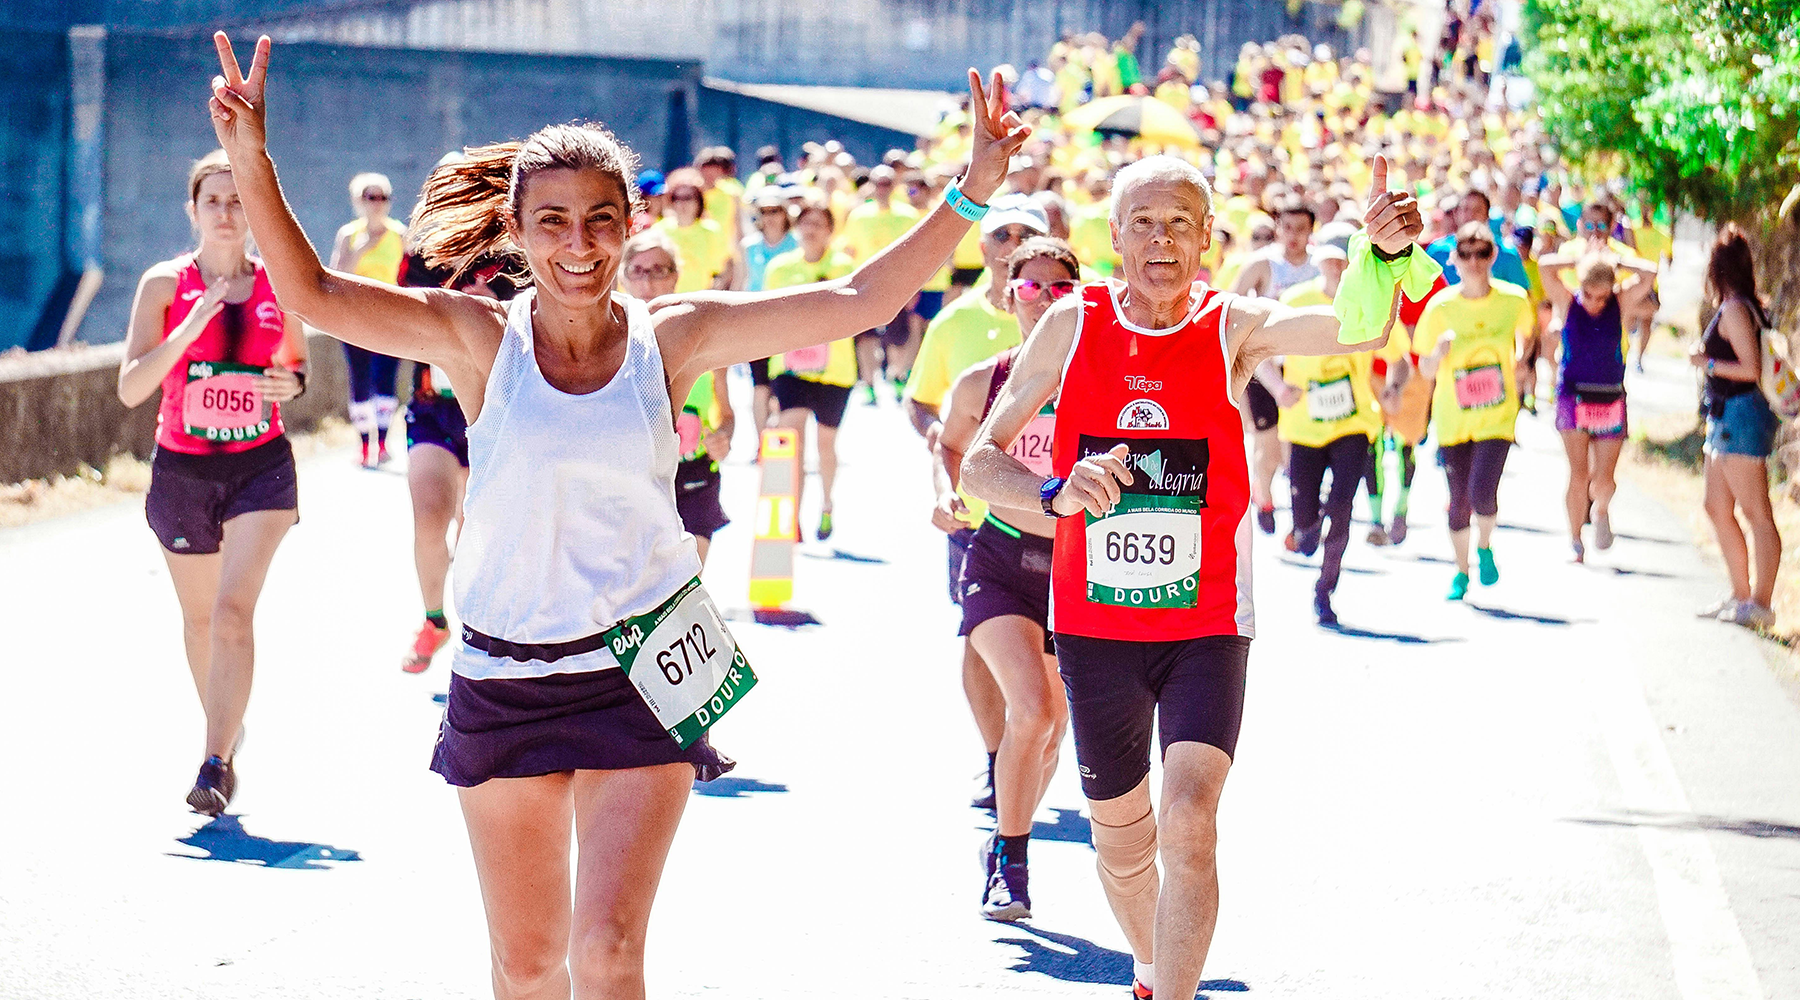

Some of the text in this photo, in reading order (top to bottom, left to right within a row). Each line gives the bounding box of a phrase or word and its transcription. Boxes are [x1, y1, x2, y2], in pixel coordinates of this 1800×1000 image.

[203, 388, 254, 412] 6056
[207, 421, 269, 440] DOURO
[1149, 458, 1204, 496] alegria
[1106, 531, 1175, 565] 6639
[1114, 576, 1197, 605] DOURO
[656, 623, 717, 686] 6712
[694, 650, 746, 727] DOURO
